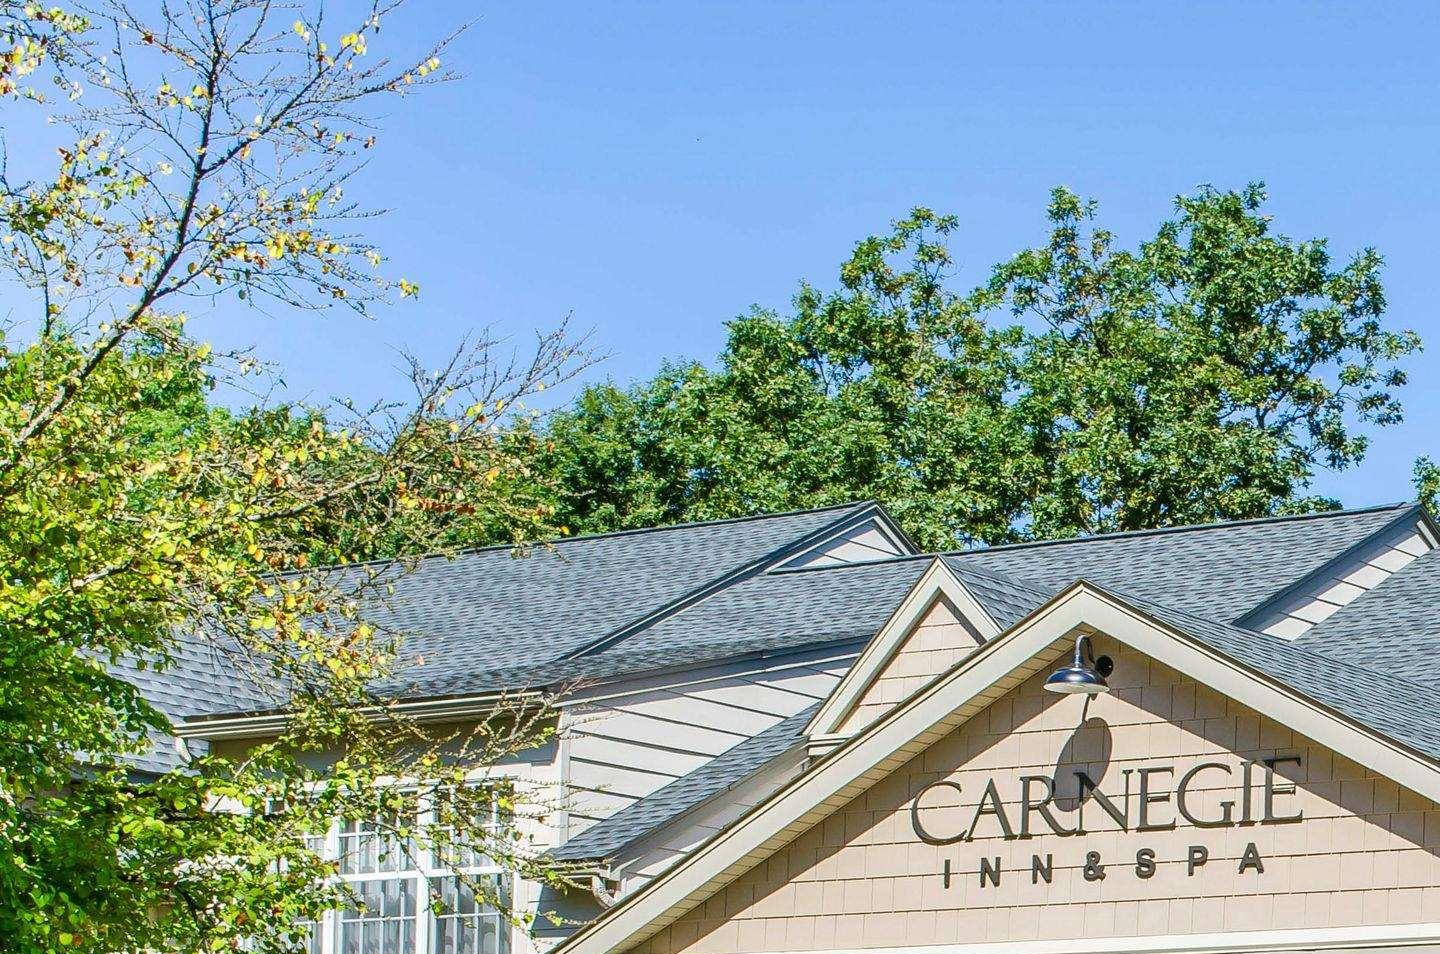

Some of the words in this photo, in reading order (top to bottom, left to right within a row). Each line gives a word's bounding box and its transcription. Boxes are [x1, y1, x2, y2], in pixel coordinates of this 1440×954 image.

[910, 756, 1303, 846] CARNEGIE
[943, 853, 1053, 889] INN
[1083, 850, 1106, 882] &
[1135, 842, 1265, 879] SPA
